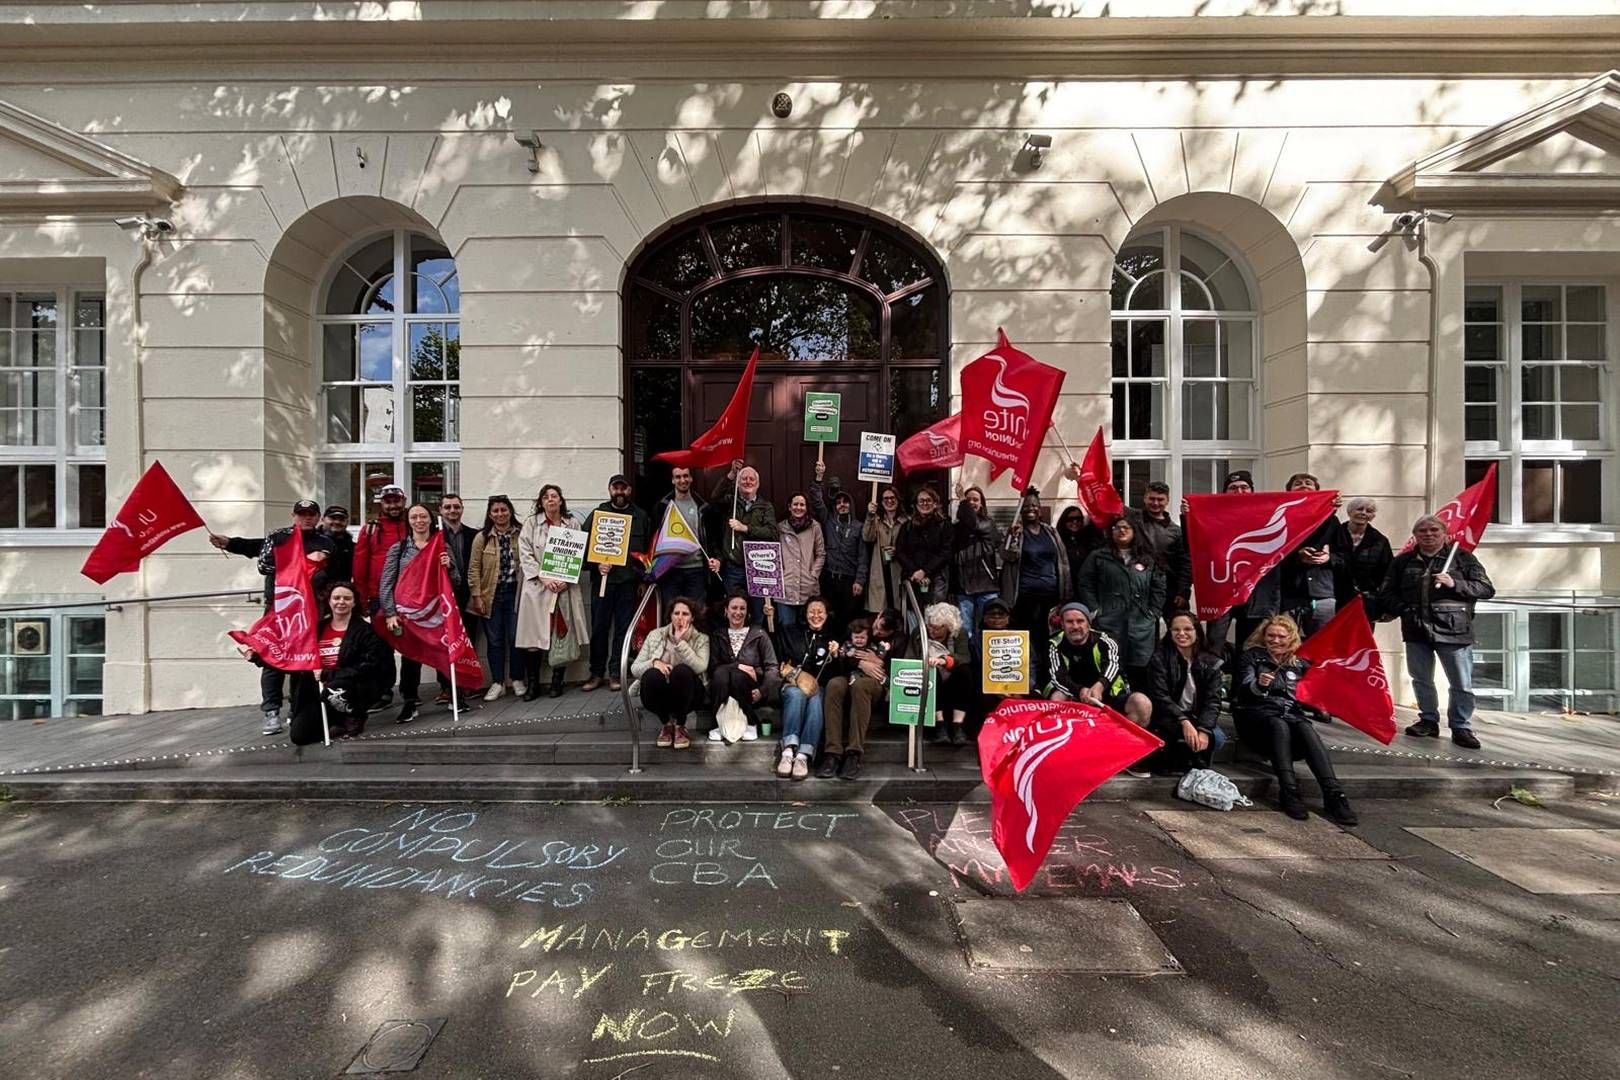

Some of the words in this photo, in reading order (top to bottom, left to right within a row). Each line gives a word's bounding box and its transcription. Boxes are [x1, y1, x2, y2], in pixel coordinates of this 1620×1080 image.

[866, 434, 882, 442] COME
[549, 537, 584, 550] BETRAYING
[552, 547, 578, 557] UNIONS
[751, 551, 775, 559] Where's
[755, 561, 774, 569] Steve?
[1003, 637, 1020, 645] Staff
[389, 808, 480, 833] NO
[660, 808, 860, 838] PROTECT
[655, 838, 757, 859] OUR
[223, 851, 594, 908] REDUNDANCIES
[650, 861, 779, 889] CBA
[518, 923, 850, 955] MANAGEMENT
[505, 962, 614, 999] PAY
[591, 1008, 737, 1042] NOW
